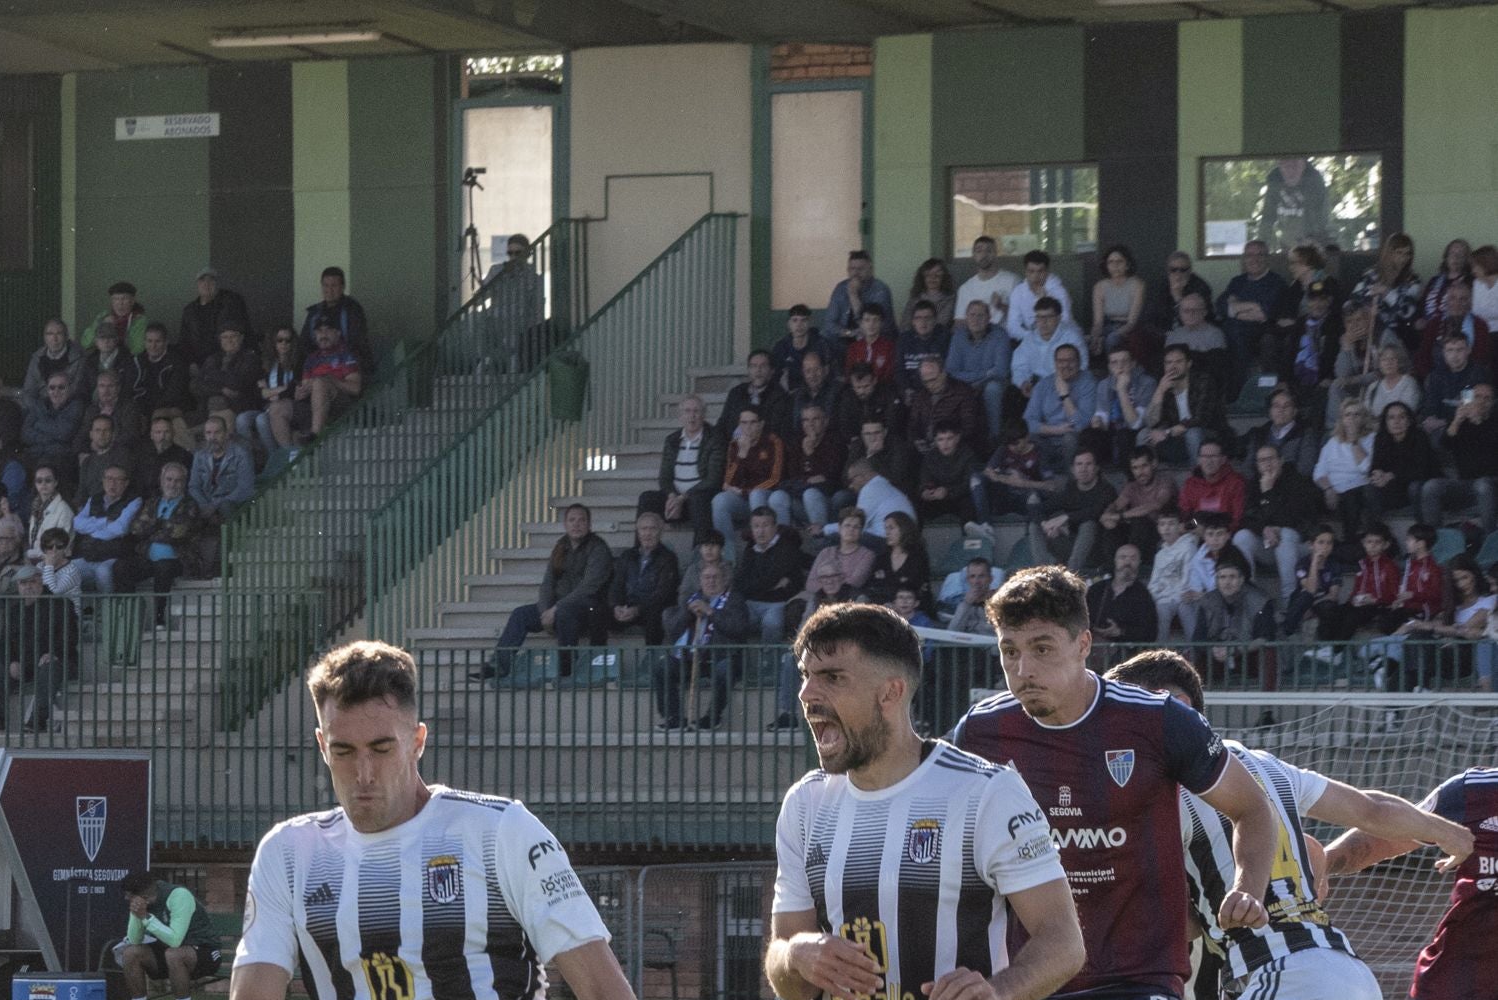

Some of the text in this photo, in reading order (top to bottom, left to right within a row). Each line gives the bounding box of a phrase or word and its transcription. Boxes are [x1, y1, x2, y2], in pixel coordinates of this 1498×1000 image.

[1049, 807, 1082, 816] SEGOVIA
[1479, 856, 1498, 874] BI
[53, 867, 93, 881] GIMNÁSTICA
